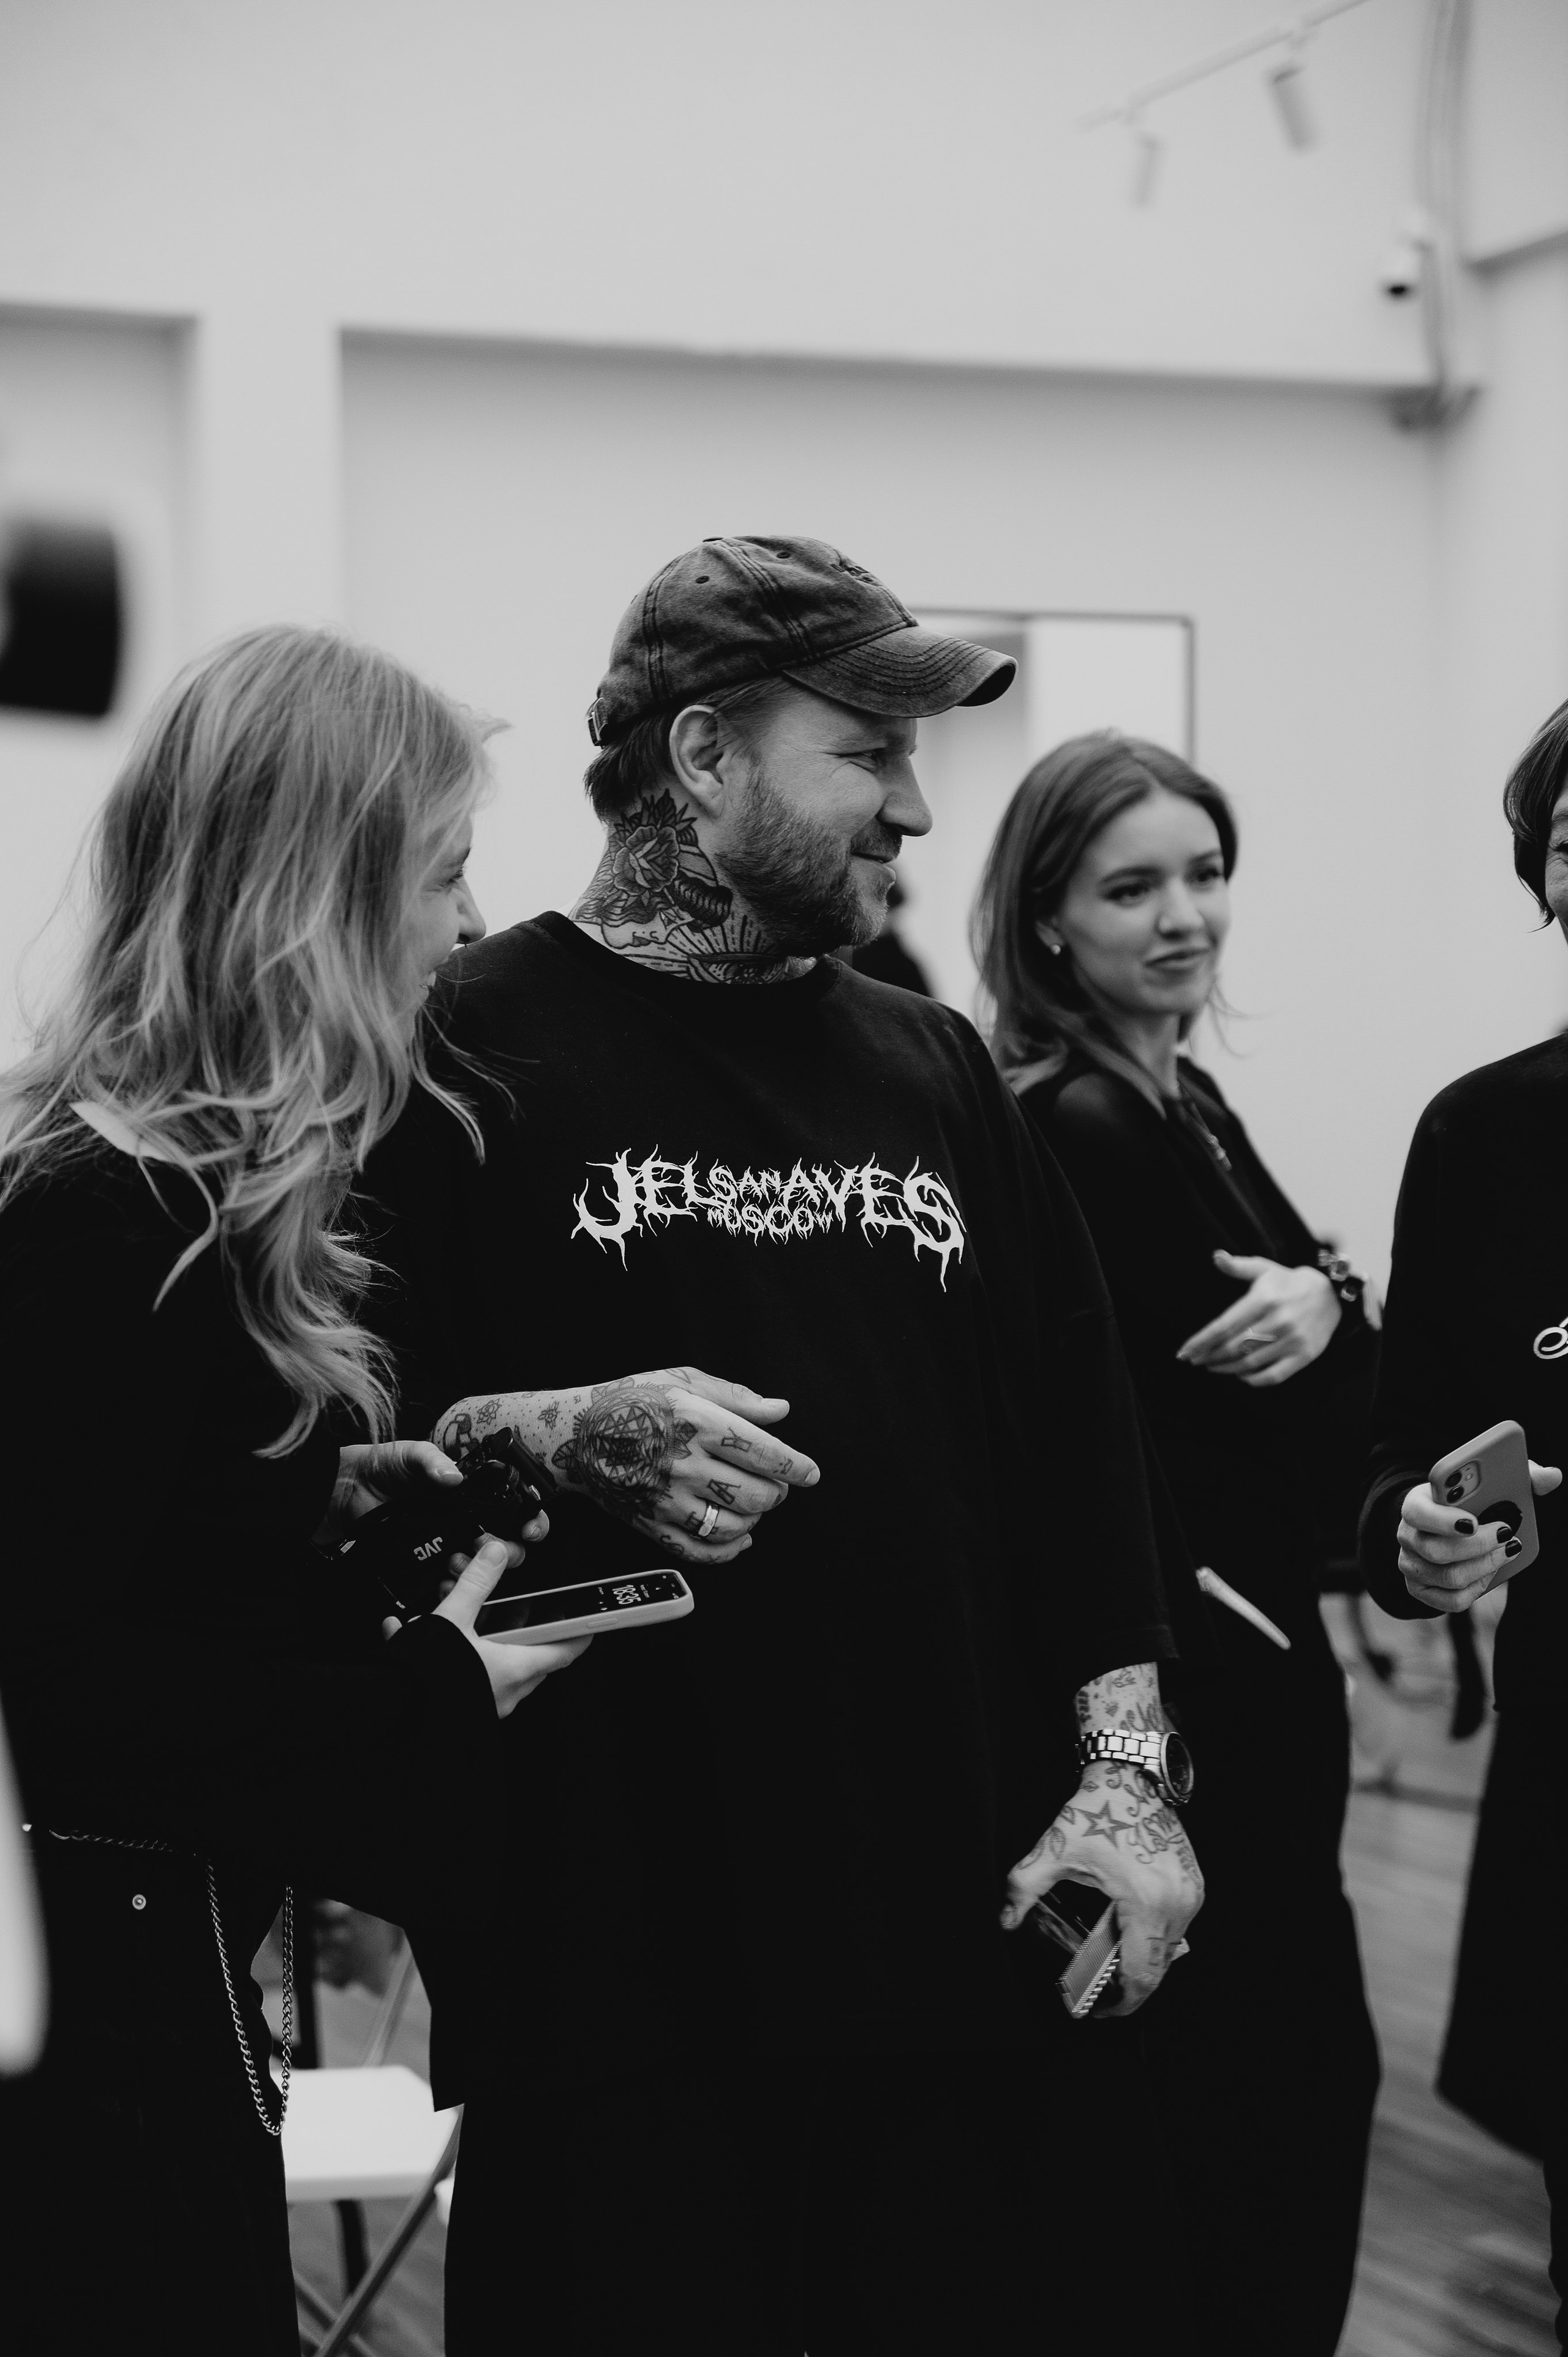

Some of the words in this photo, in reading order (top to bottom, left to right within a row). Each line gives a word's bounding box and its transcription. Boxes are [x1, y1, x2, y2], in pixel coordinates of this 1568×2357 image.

[707, 1198, 834, 1246] MOSCOW
[413, 1537, 443, 1561] JVC
[612, 1584, 642, 1605] 18:35
